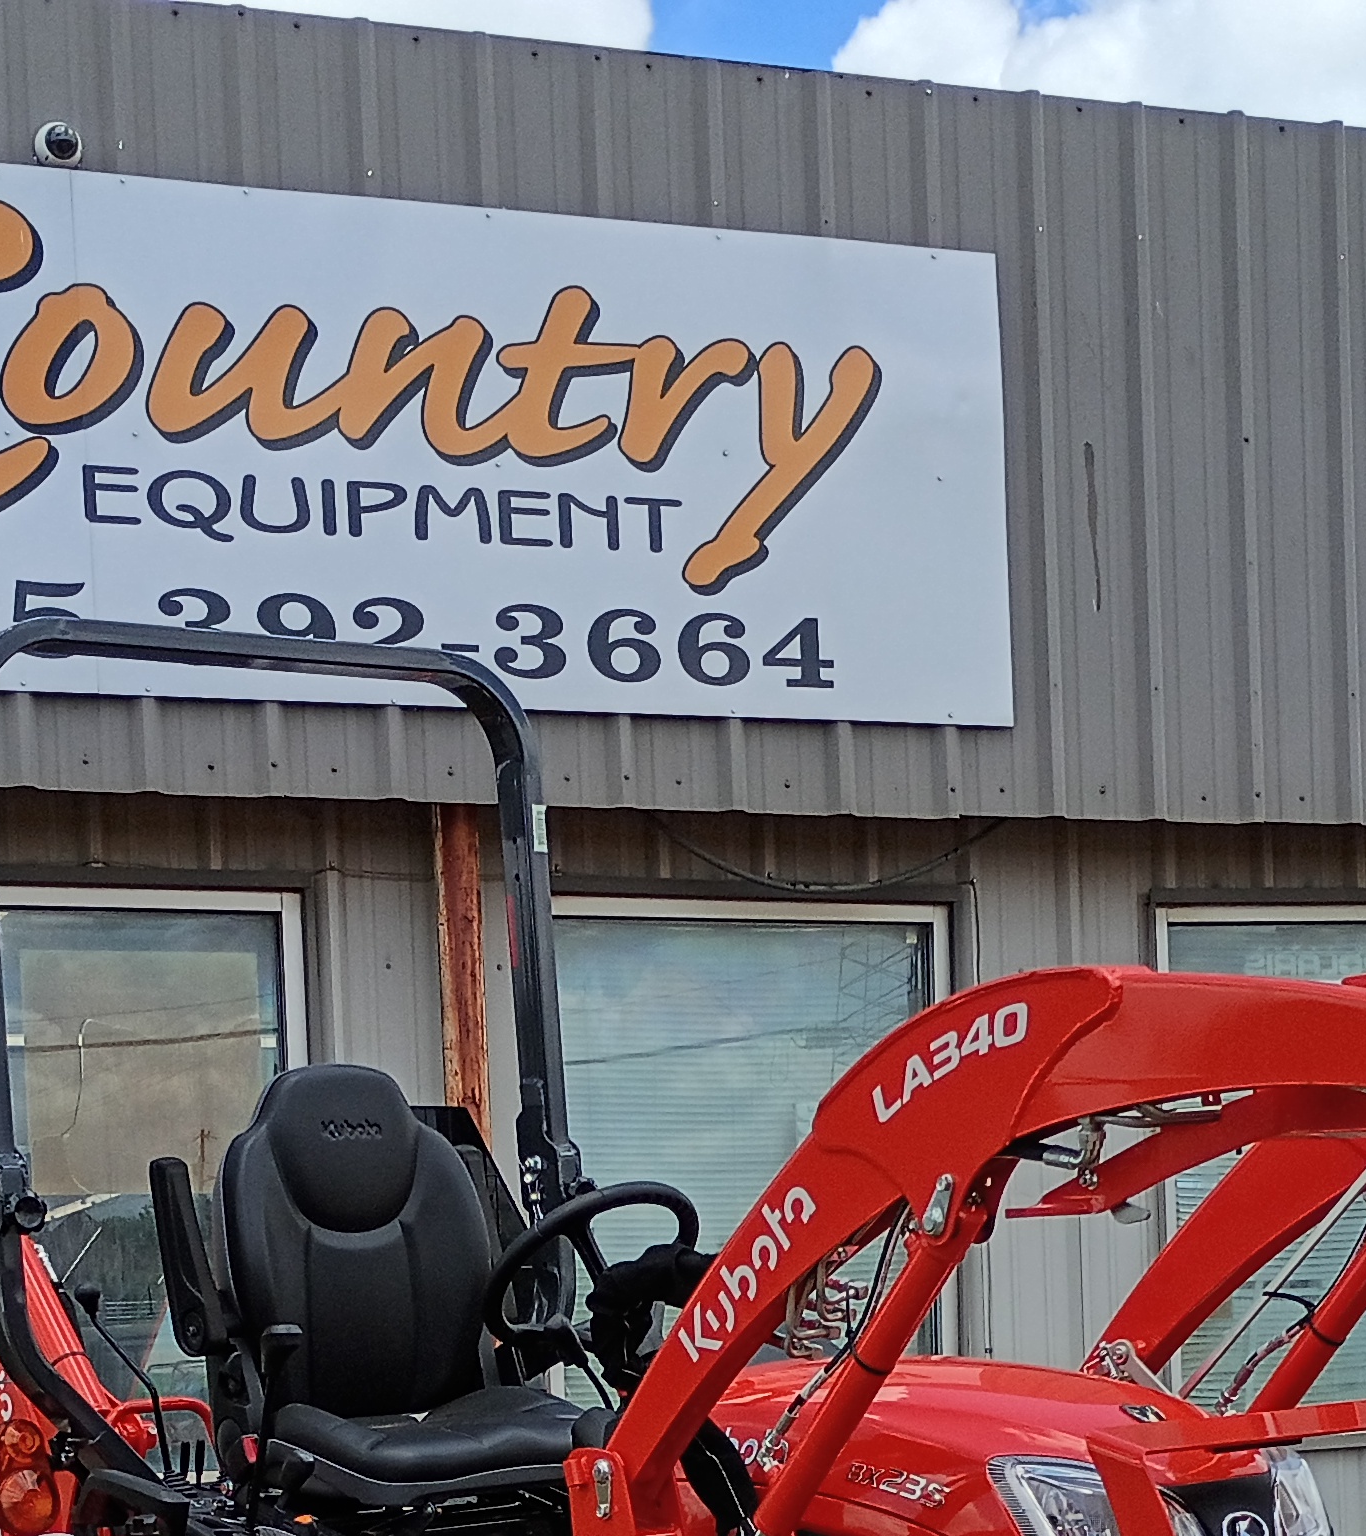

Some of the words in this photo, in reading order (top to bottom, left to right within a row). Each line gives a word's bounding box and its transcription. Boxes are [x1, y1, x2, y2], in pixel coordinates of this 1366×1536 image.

[83, 464, 683, 553] EQUIPMENT
[871, 1002, 1029, 1123] LA340
[319, 1118, 383, 1140] Kubota
[678, 1186, 817, 1363] Kubota
[847, 1460, 951, 1509] BX23S
